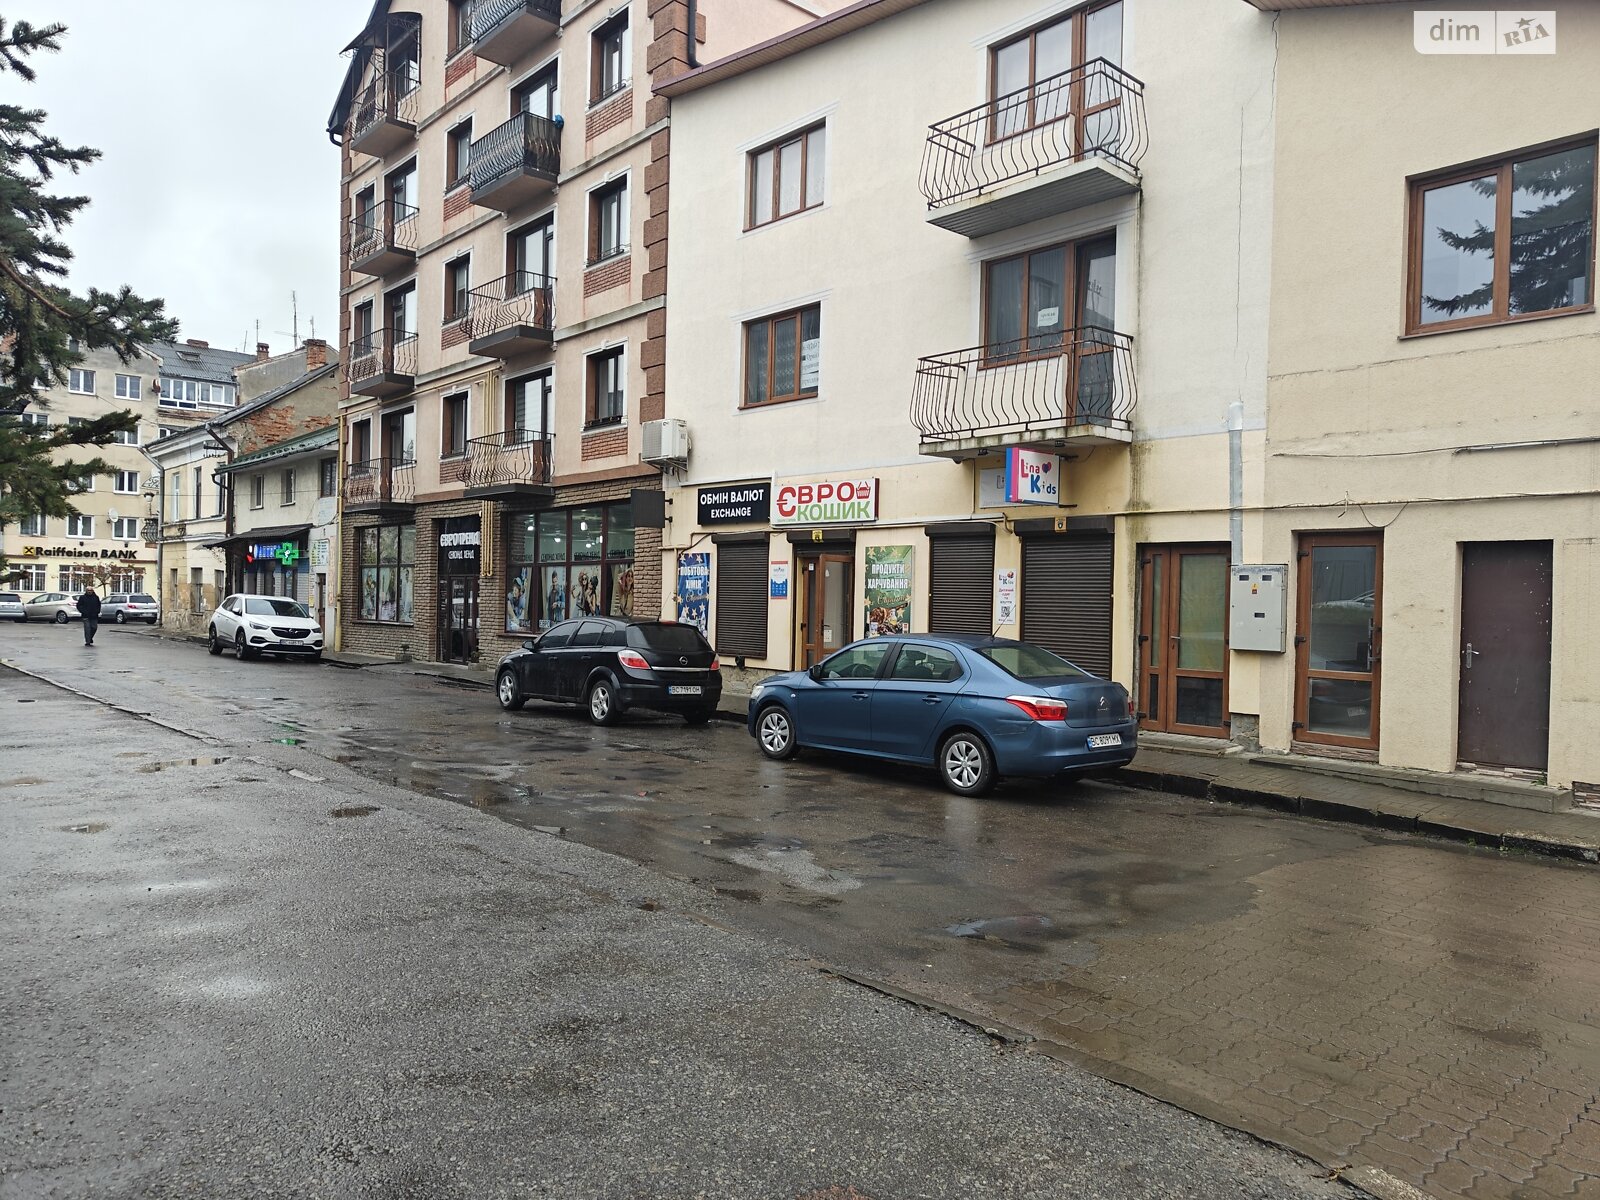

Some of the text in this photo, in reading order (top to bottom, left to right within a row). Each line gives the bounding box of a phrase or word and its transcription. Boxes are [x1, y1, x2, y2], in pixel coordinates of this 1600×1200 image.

[1020, 458, 1040, 478] Lina
[1030, 474, 1057, 494] Kids
[700, 489, 764, 505] ОБМІН ВАЛЮТ
[711, 507, 752, 519] EXCHANGE
[797, 501, 870, 521] КОШИК
[35, 546, 138, 559] Raiffeisen BANK
[871, 563, 905, 576] ПРОДУКТИ
[867, 578, 908, 589] ХАРЧУВАННЯ
